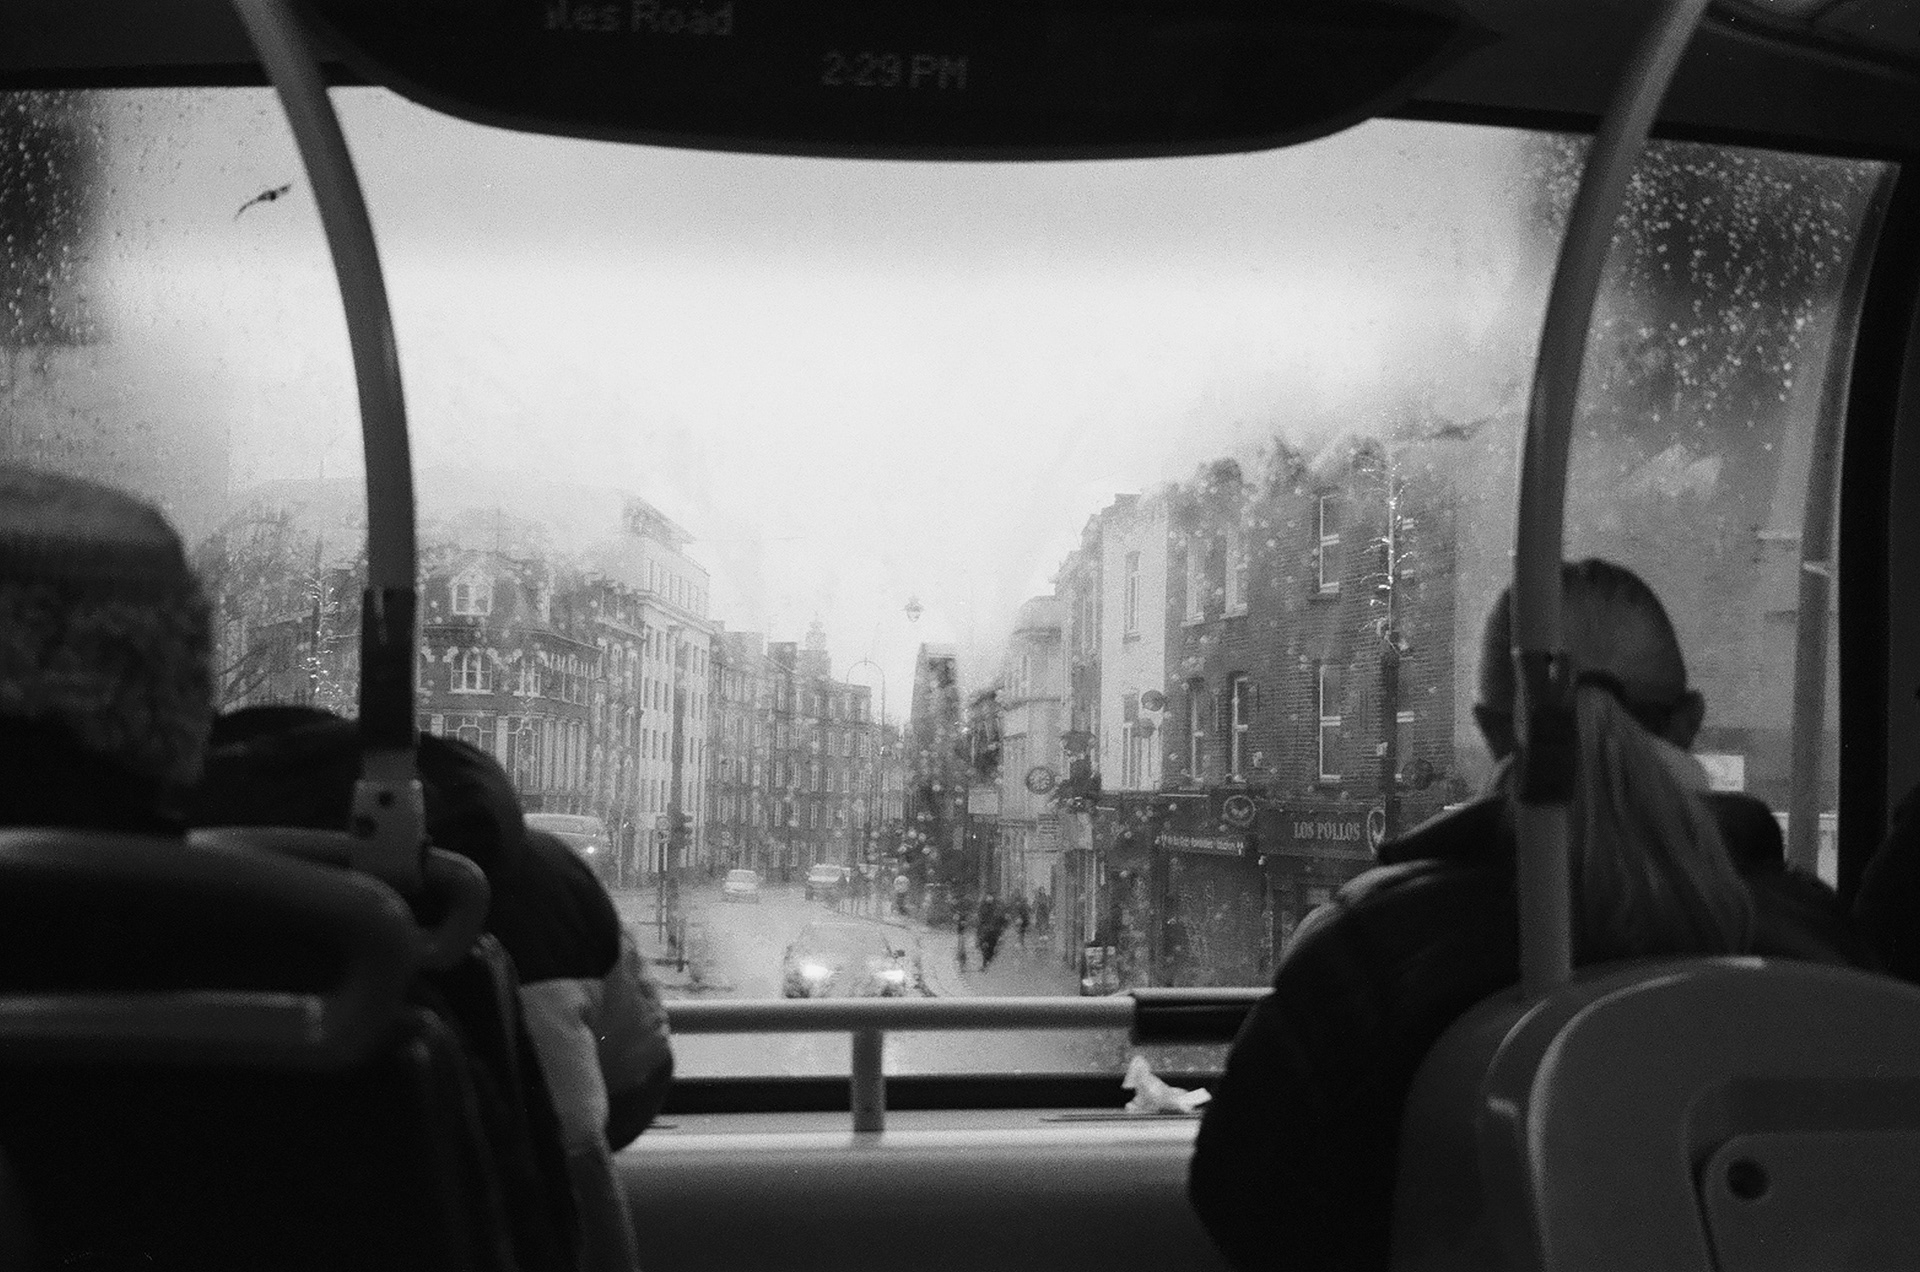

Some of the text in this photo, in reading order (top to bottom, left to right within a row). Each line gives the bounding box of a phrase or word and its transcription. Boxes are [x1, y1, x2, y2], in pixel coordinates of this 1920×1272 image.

[631, 0, 734, 35] Road
[821, 49, 970, 90] 2:29 PM
[1293, 821, 1361, 841] LOS POLLOS
